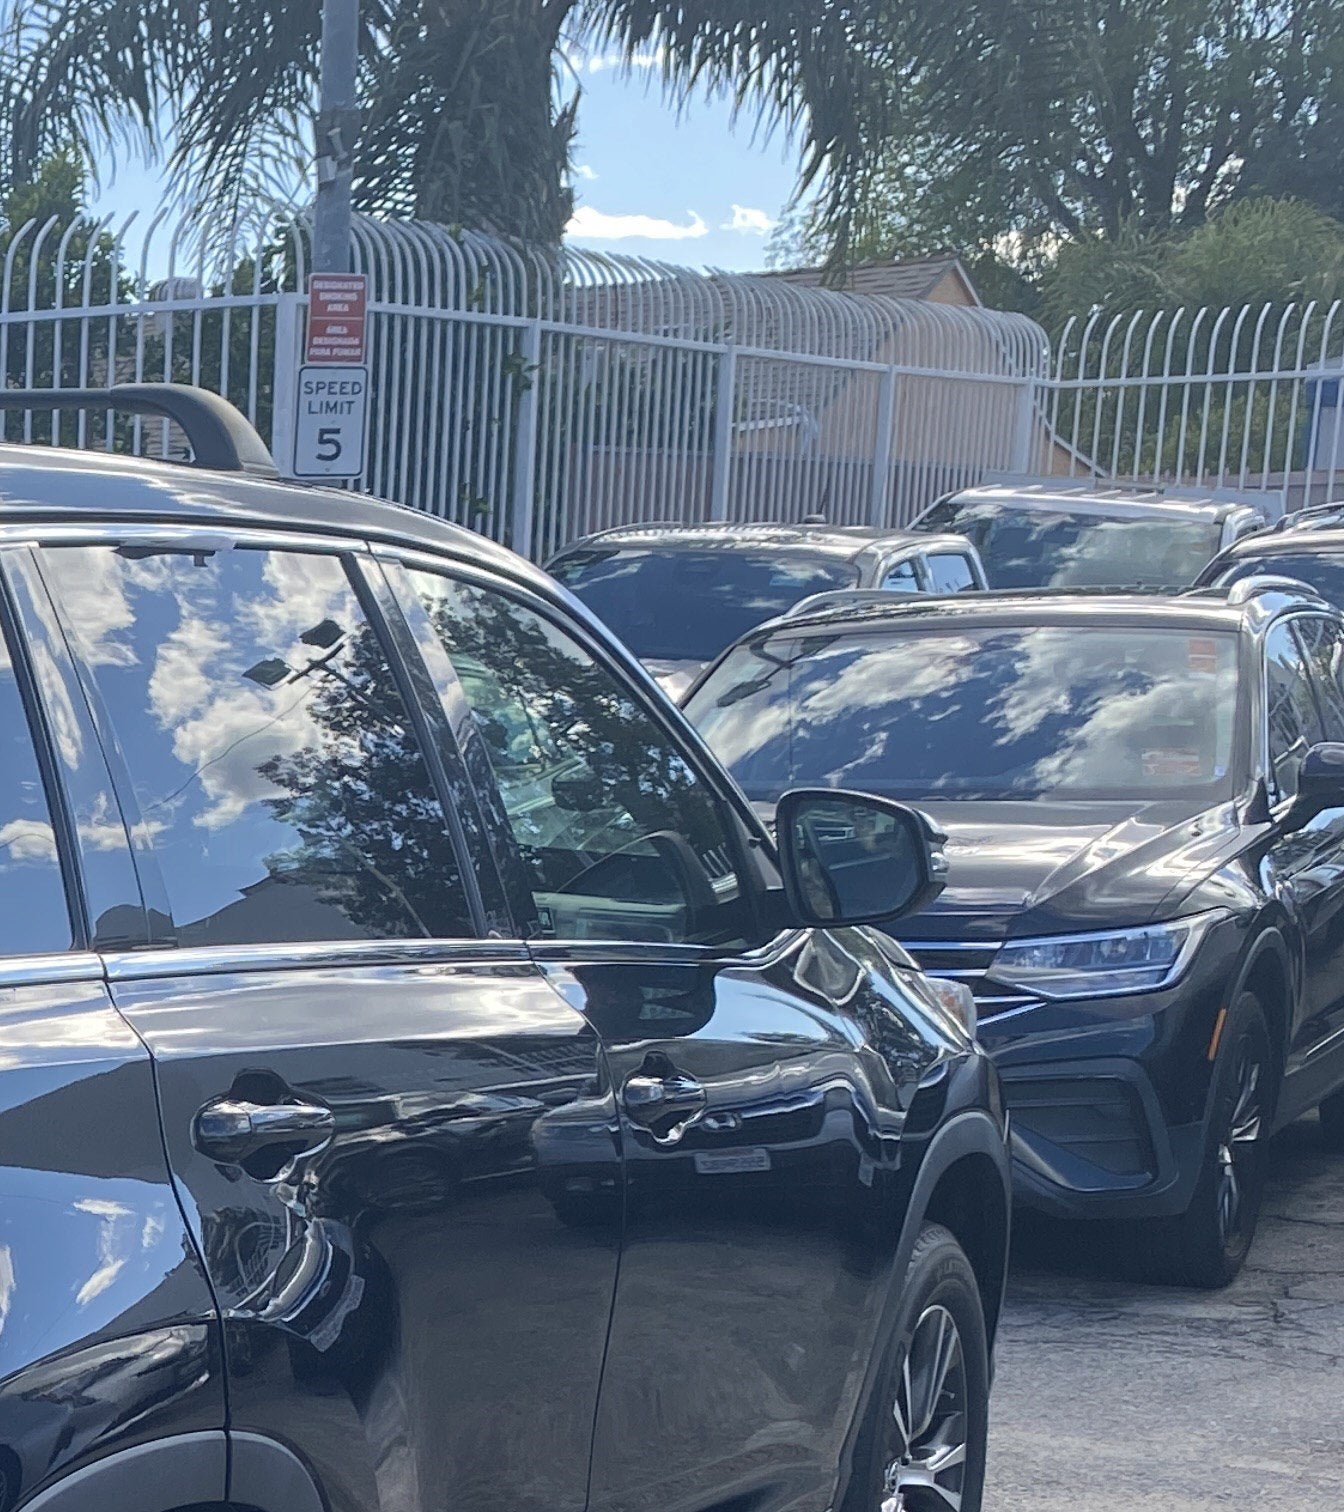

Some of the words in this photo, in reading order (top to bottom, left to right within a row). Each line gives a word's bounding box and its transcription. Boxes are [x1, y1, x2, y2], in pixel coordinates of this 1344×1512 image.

[303, 381, 362, 396] SPEED
[308, 401, 355, 415] LIMIT
[316, 428, 342, 461] 5
